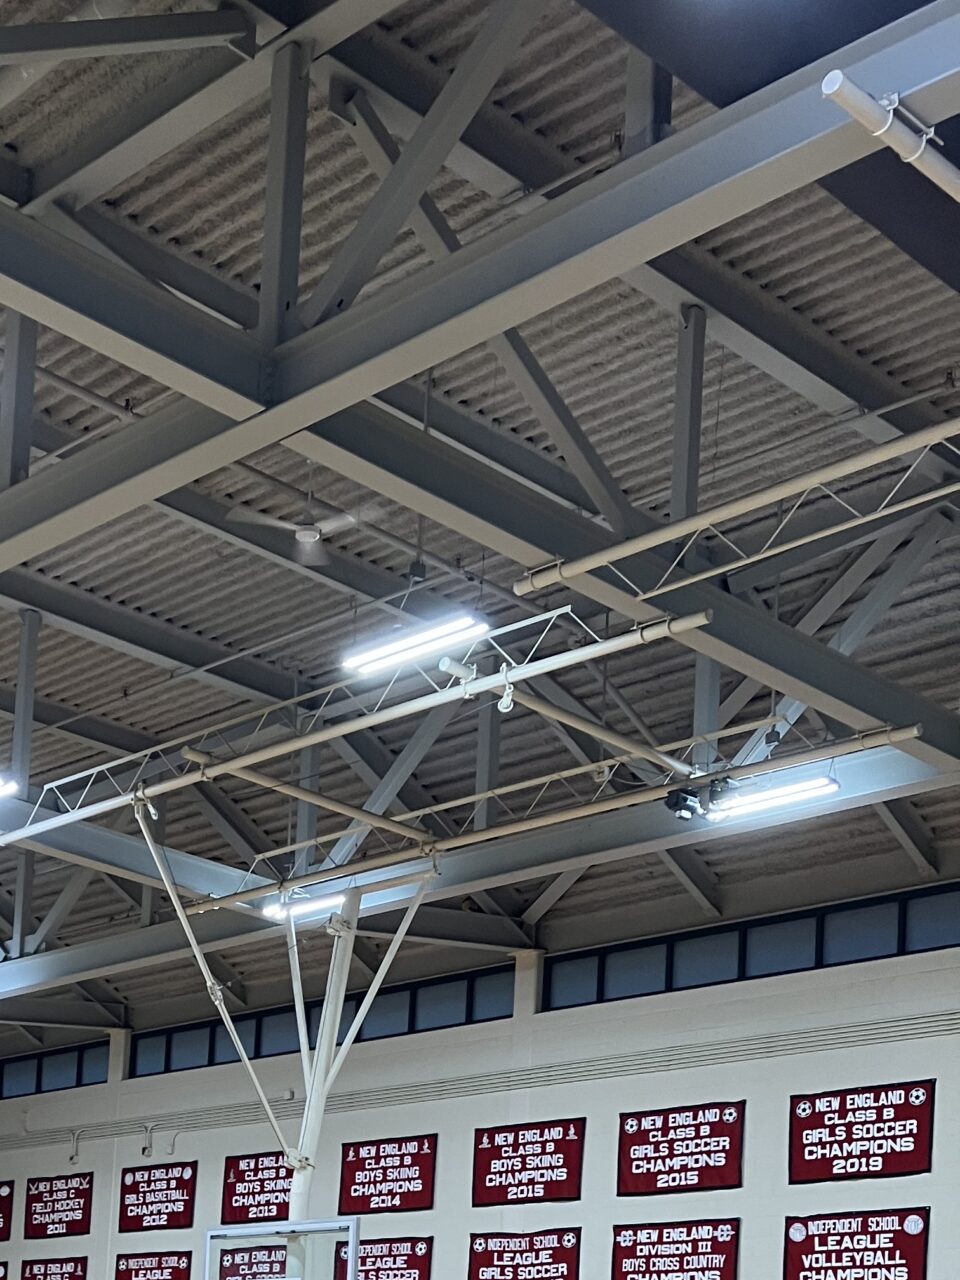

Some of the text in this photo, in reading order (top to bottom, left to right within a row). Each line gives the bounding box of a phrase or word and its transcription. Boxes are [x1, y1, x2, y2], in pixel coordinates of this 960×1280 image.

[815, 1089, 905, 1112] NEW ENGLAND
[640, 1108, 720, 1130] NEW ENGLAND
[824, 1107, 894, 1125] CLASS B
[494, 1126, 563, 1146] NEW ENGLAND
[648, 1124, 710, 1142] CLASS B
[802, 1119, 917, 1144] GIRLS SOCCER
[359, 1141, 418, 1158] NEW ENGLAND
[501, 1141, 554, 1157] CLASS B
[630, 1136, 730, 1158] GIRLS SOCCER
[804, 1136, 914, 1160] CHAMPIONS
[365, 1155, 411, 1169] CLASS B
[490, 1153, 564, 1172] BOYS SKIING
[631, 1152, 726, 1173] CHAMPIONS
[832, 1156, 882, 1173] 2019
[355, 1165, 419, 1183] BOYS SKIING
[485, 1167, 567, 1186] CHAMPIONS
[656, 1170, 698, 1187] 2015
[350, 1179, 422, 1196] CHAMPIONS
[507, 1184, 544, 1199] 2015
[369, 1194, 400, 1208] 2014
[867, 1215, 901, 1231] SCHOOL
[533, 1234, 560, 1249] SCHOOL
[636, 1225, 713, 1243] NEW ENGLAND
[814, 1232, 893, 1251] LEAGUE
[493, 1249, 553, 1265] LEAGUE
[636, 1241, 712, 1256] DIVISION III
[621, 1254, 726, 1271] BOYS CROSS COUNTRY
[801, 1249, 906, 1268] VOLLEYBALL
[131, 1268, 172, 1280] LEAGUE
[478, 1263, 567, 1279] GIRLS SOCCER
